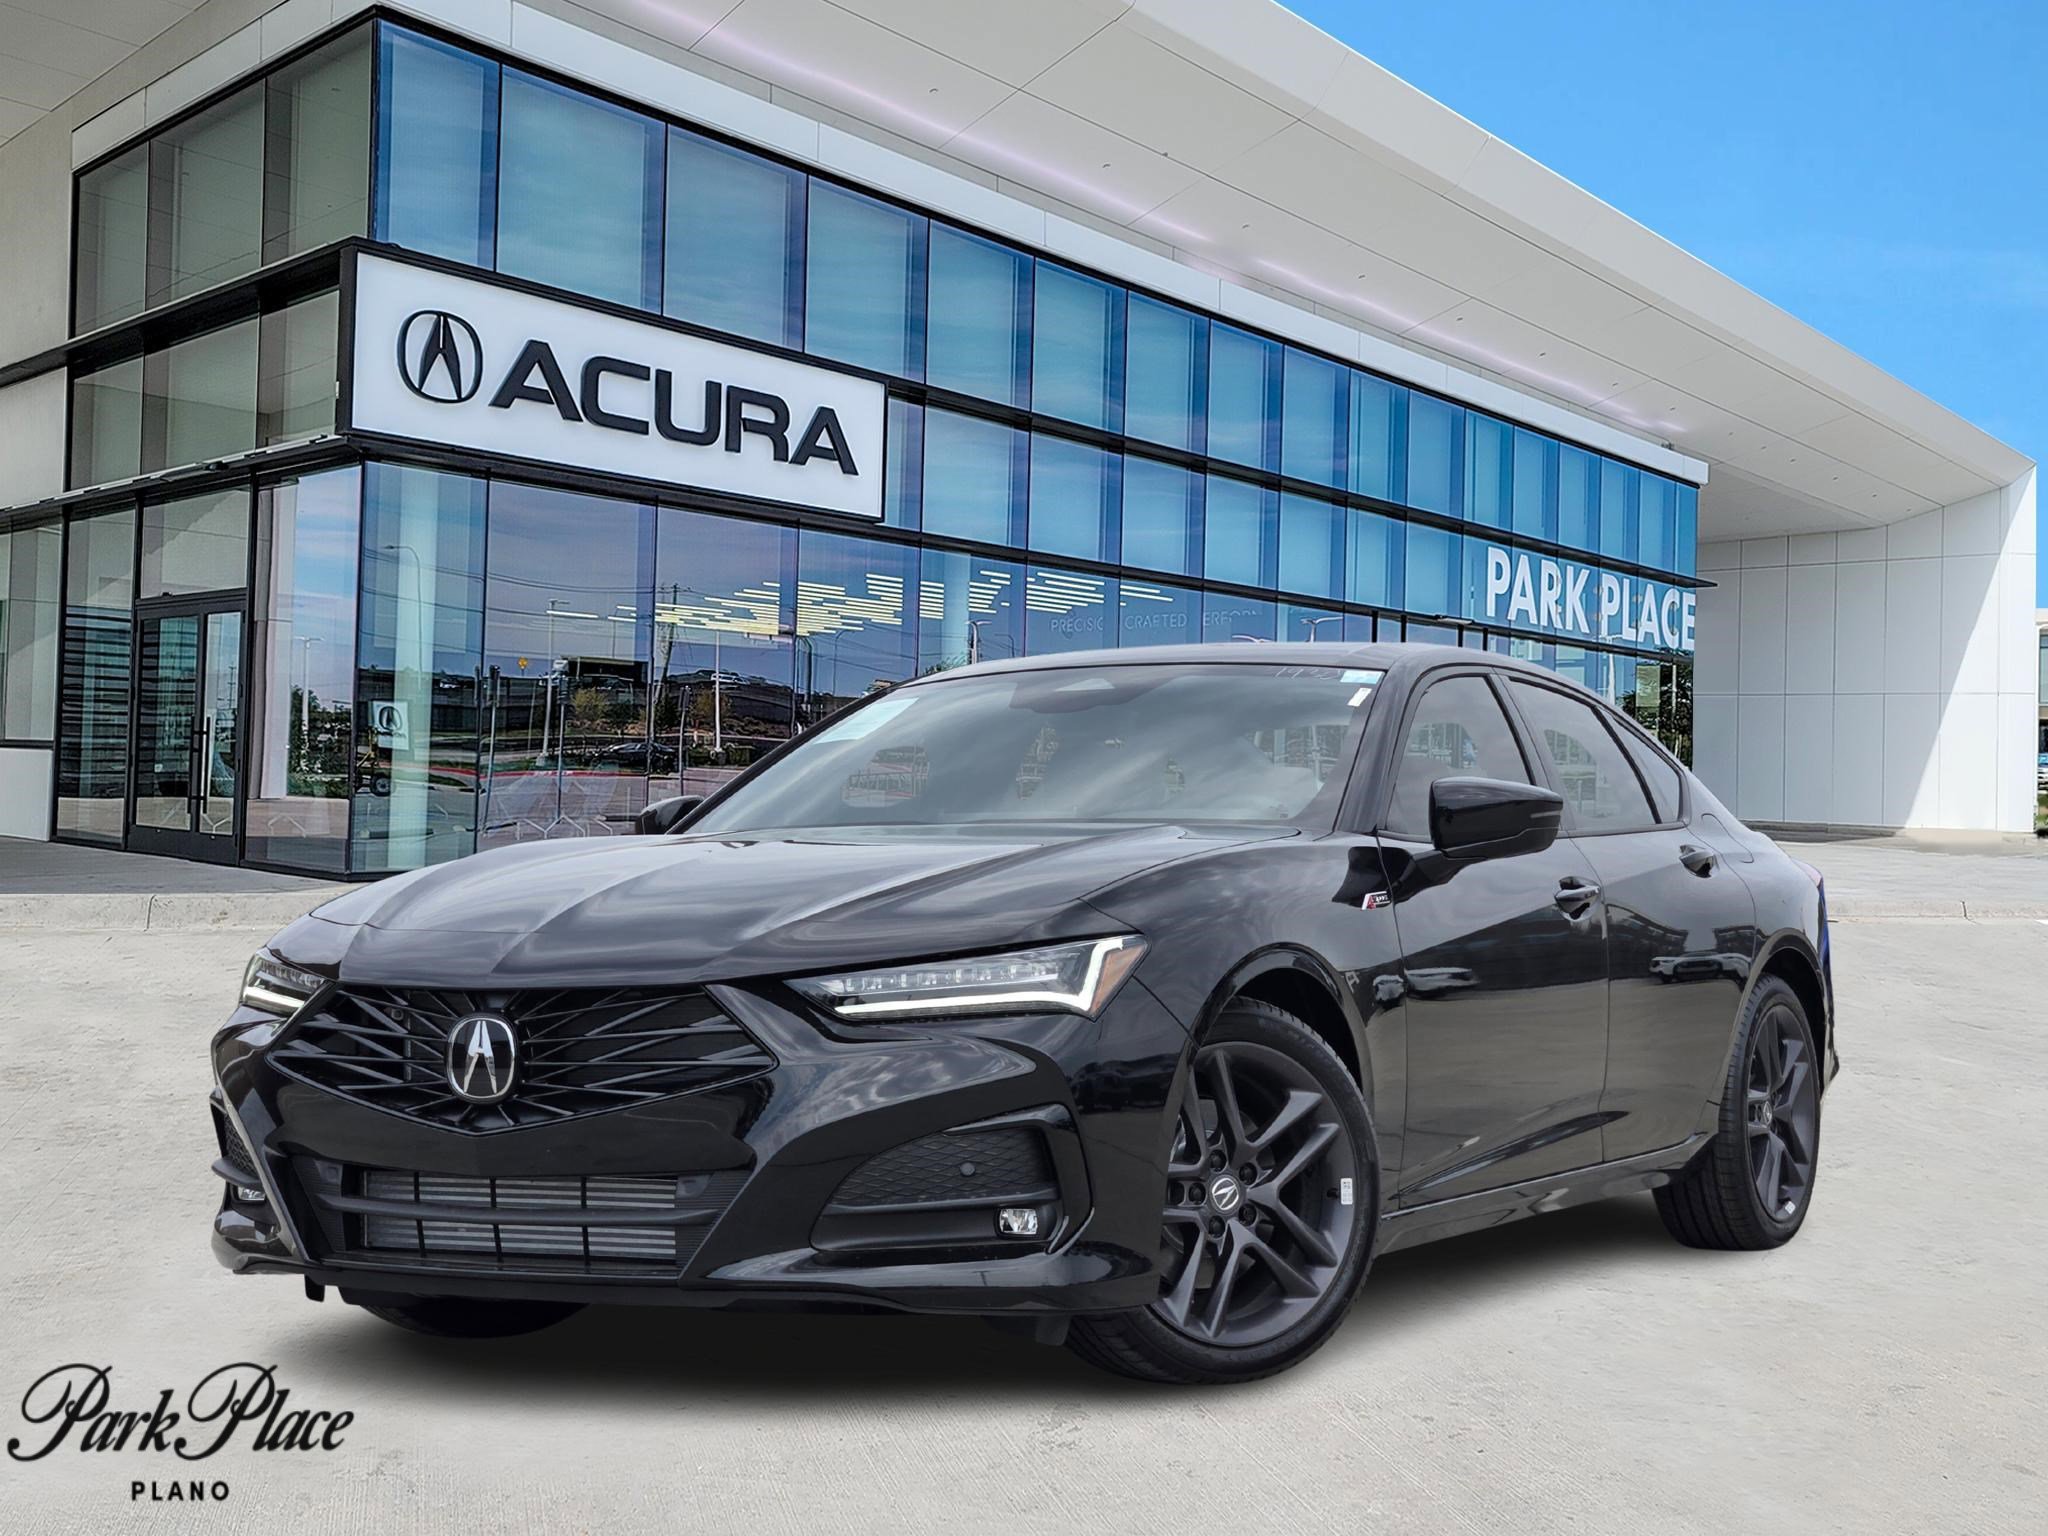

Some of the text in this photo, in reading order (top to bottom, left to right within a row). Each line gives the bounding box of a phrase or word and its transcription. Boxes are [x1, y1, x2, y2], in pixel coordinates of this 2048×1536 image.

[488, 339, 859, 476] ACURA
[1124, 613, 1188, 631] CRAFTED
[1486, 546, 1696, 650] PARK PLACE
